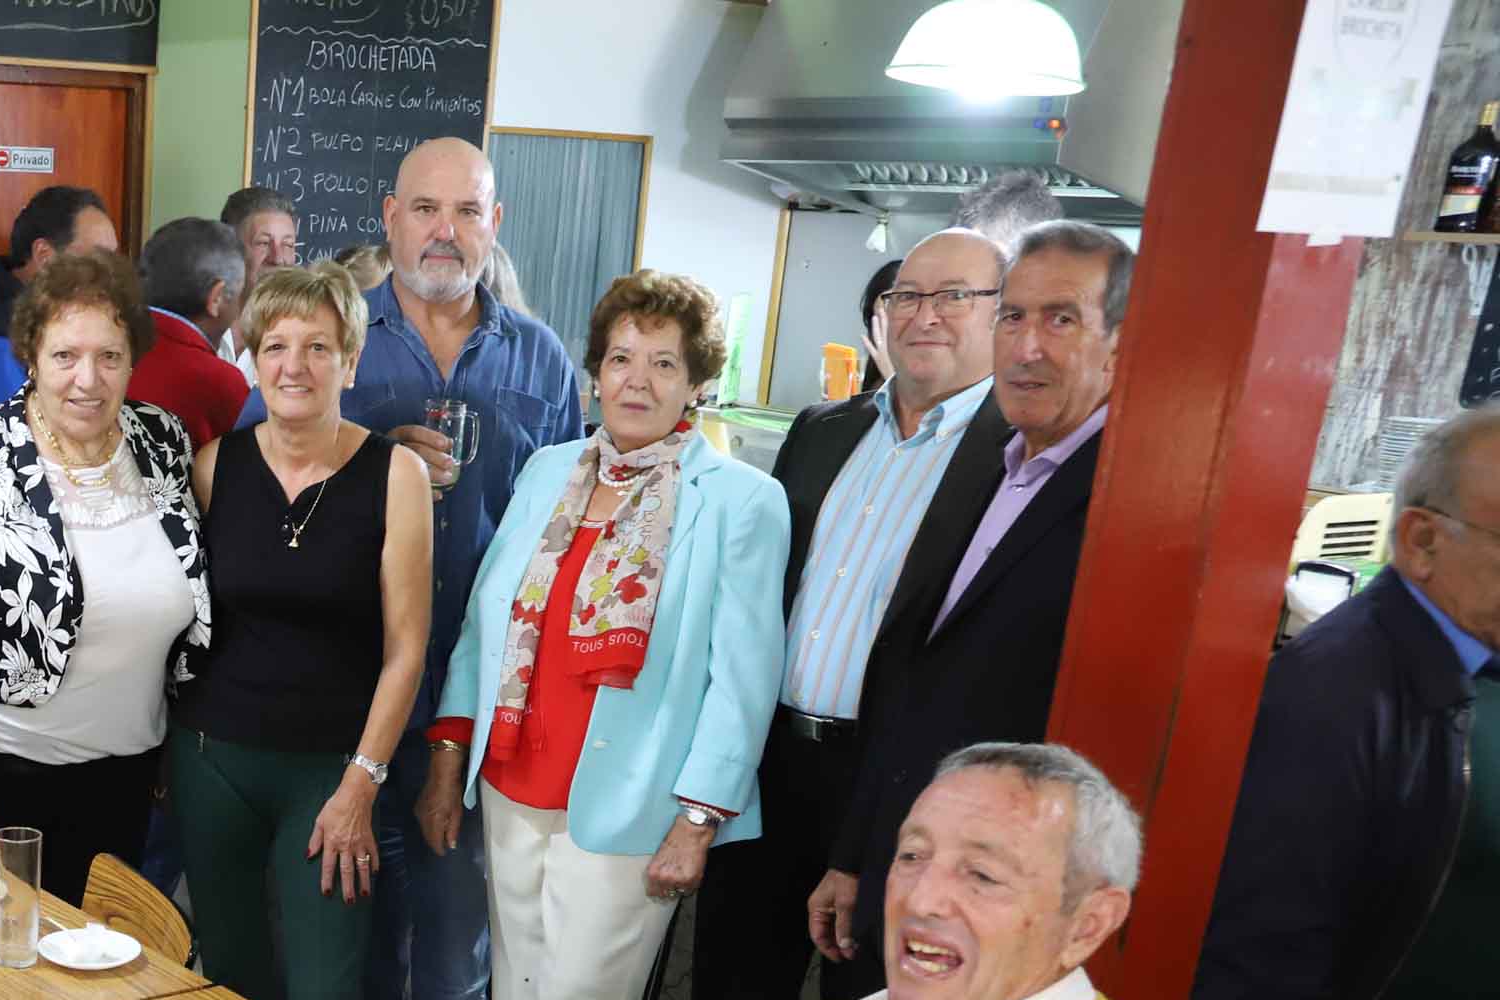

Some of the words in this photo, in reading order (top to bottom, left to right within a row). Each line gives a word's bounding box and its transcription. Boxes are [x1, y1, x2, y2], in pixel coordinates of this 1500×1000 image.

[306, 40, 437, 73] BROCHETADA
[12, 152, 50, 167] Privado
[313, 172, 370, 195] POLLO
[308, 207, 349, 233] PIÑA
[571, 639, 604, 654] TOUS
[607, 631, 645, 648] TOUS
